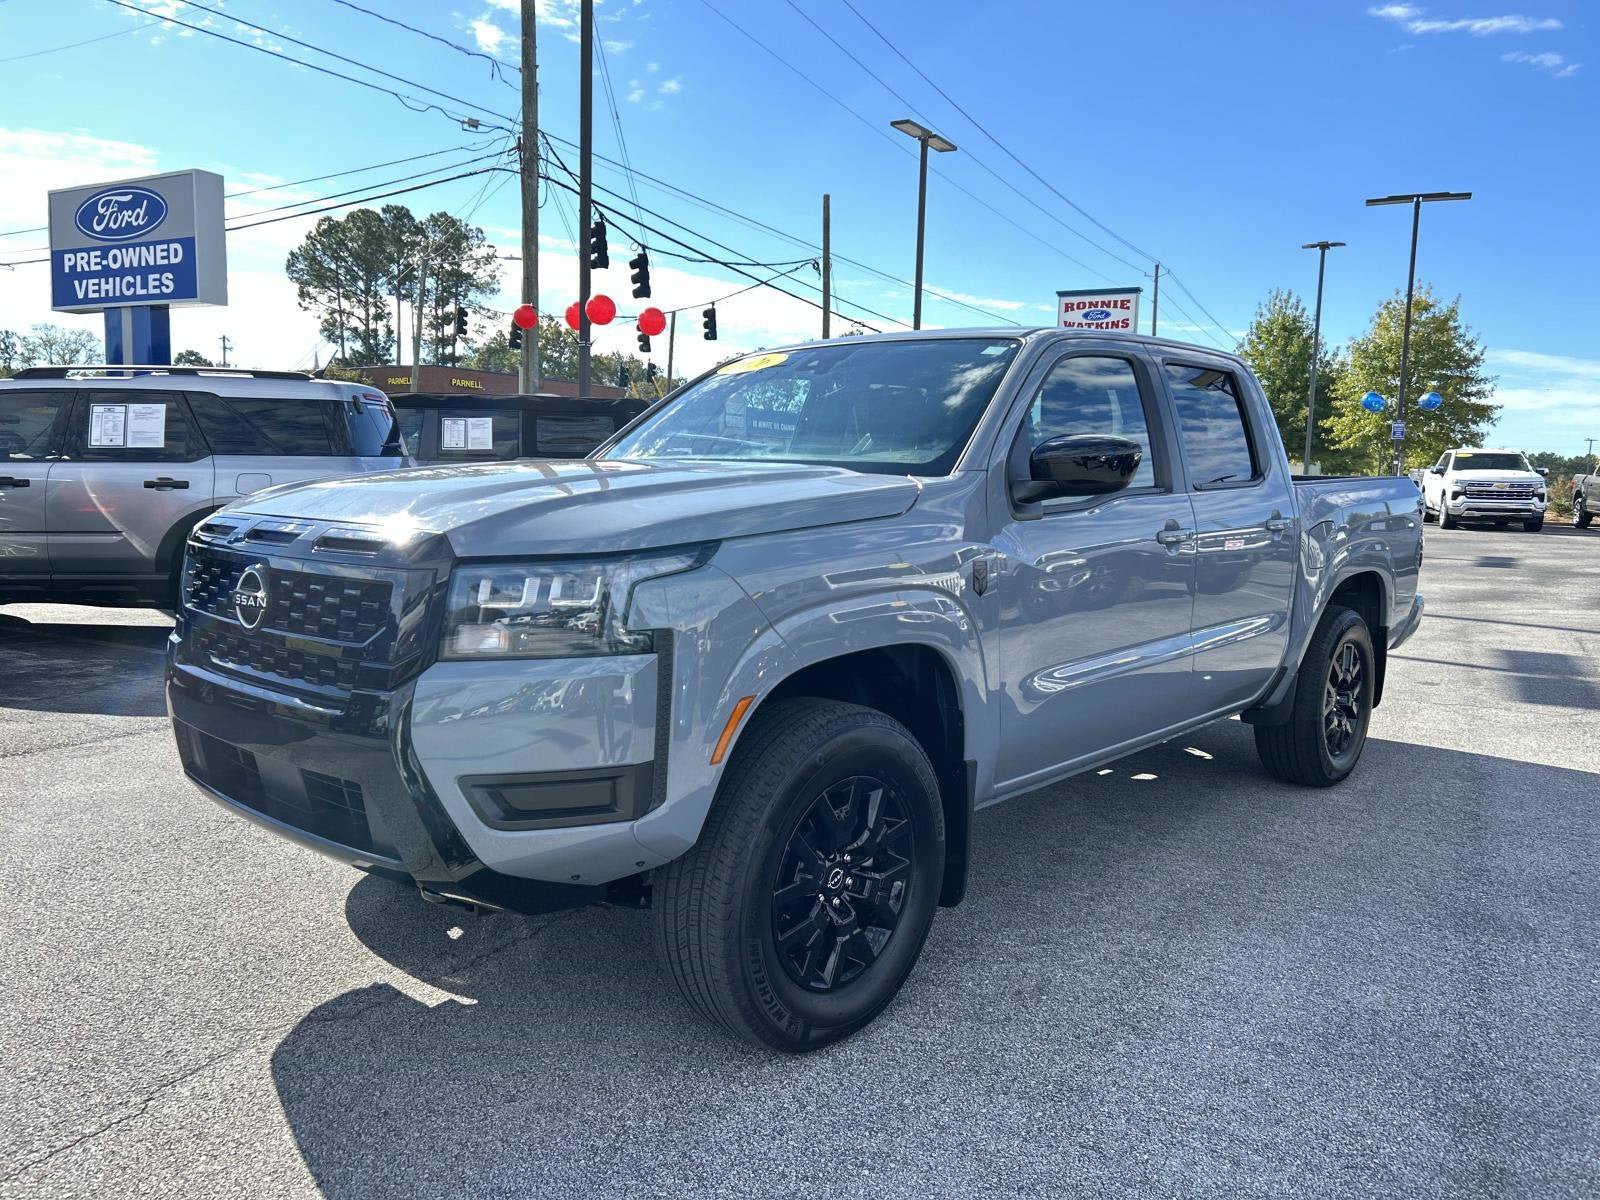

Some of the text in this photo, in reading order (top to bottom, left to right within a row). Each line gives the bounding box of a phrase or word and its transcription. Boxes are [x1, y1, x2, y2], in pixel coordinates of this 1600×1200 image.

[93, 194, 148, 232] Ford
[63, 243, 183, 273] PRE-OWNED
[74, 273, 174, 299] VEHICLES
[1064, 299, 1131, 313] RONNIE
[1087, 311, 1106, 320] Ford
[1063, 318, 1130, 330] WATKINS
[451, 378, 483, 389] PARNELL
